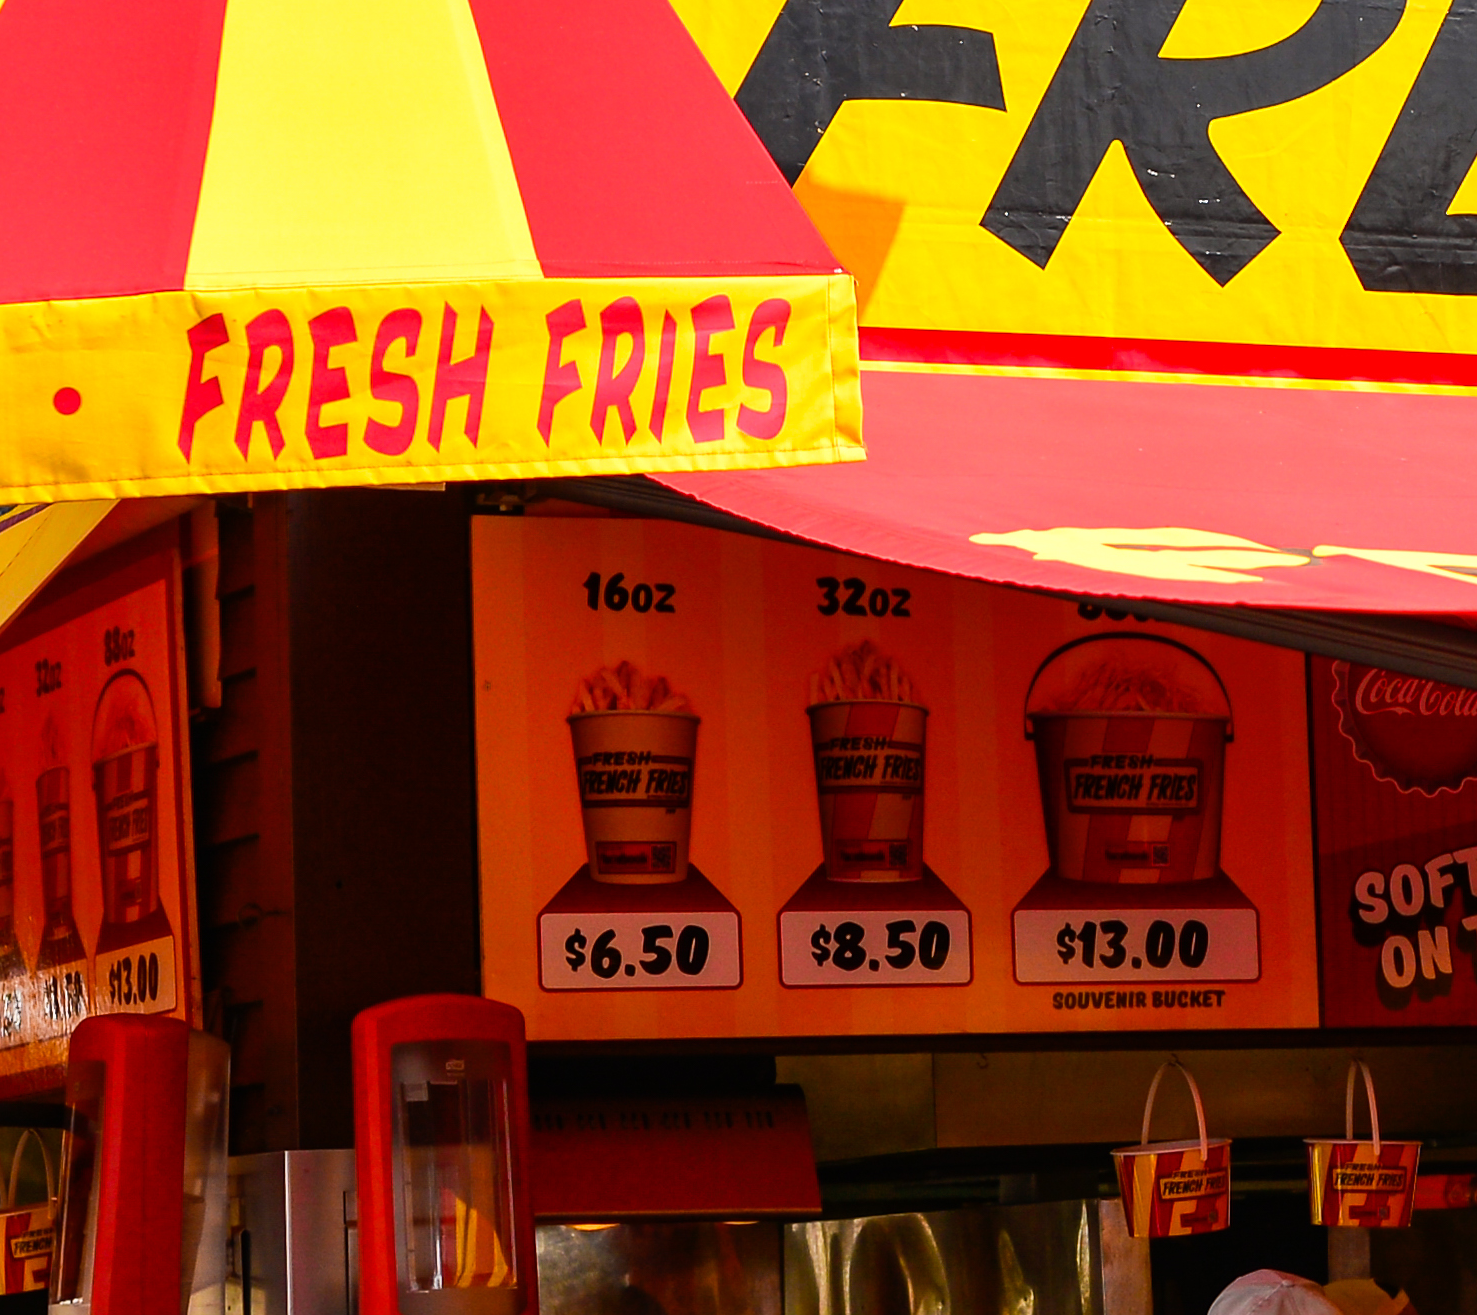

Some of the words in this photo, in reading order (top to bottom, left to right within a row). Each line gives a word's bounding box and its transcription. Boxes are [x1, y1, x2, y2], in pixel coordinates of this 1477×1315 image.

[178, 299, 495, 466] FRESH
[536, 293, 791, 448] FRIES
[820, 755, 877, 780] FRENCH
[881, 755, 921, 781] FRIES
[1088, 754, 1155, 769] FRESH
[583, 770, 641, 795] FRENCH
[645, 769, 688, 795] FRIES
[1073, 773, 1143, 800] FRENCH
[1147, 773, 1197, 801] FRIES
[565, 925, 711, 978] $6.50
[810, 919, 952, 972] $8.50
[1055, 919, 1210, 970] $13.00
[1380, 926, 1452, 991] ON
[109, 952, 159, 1006] $13.00
[1052, 992, 1148, 1012] SOUVENIR
[1151, 989, 1227, 1010] BUCKET
[1163, 1178, 1203, 1196] FRENCH
[1334, 1172, 1374, 1186] FRENCH
